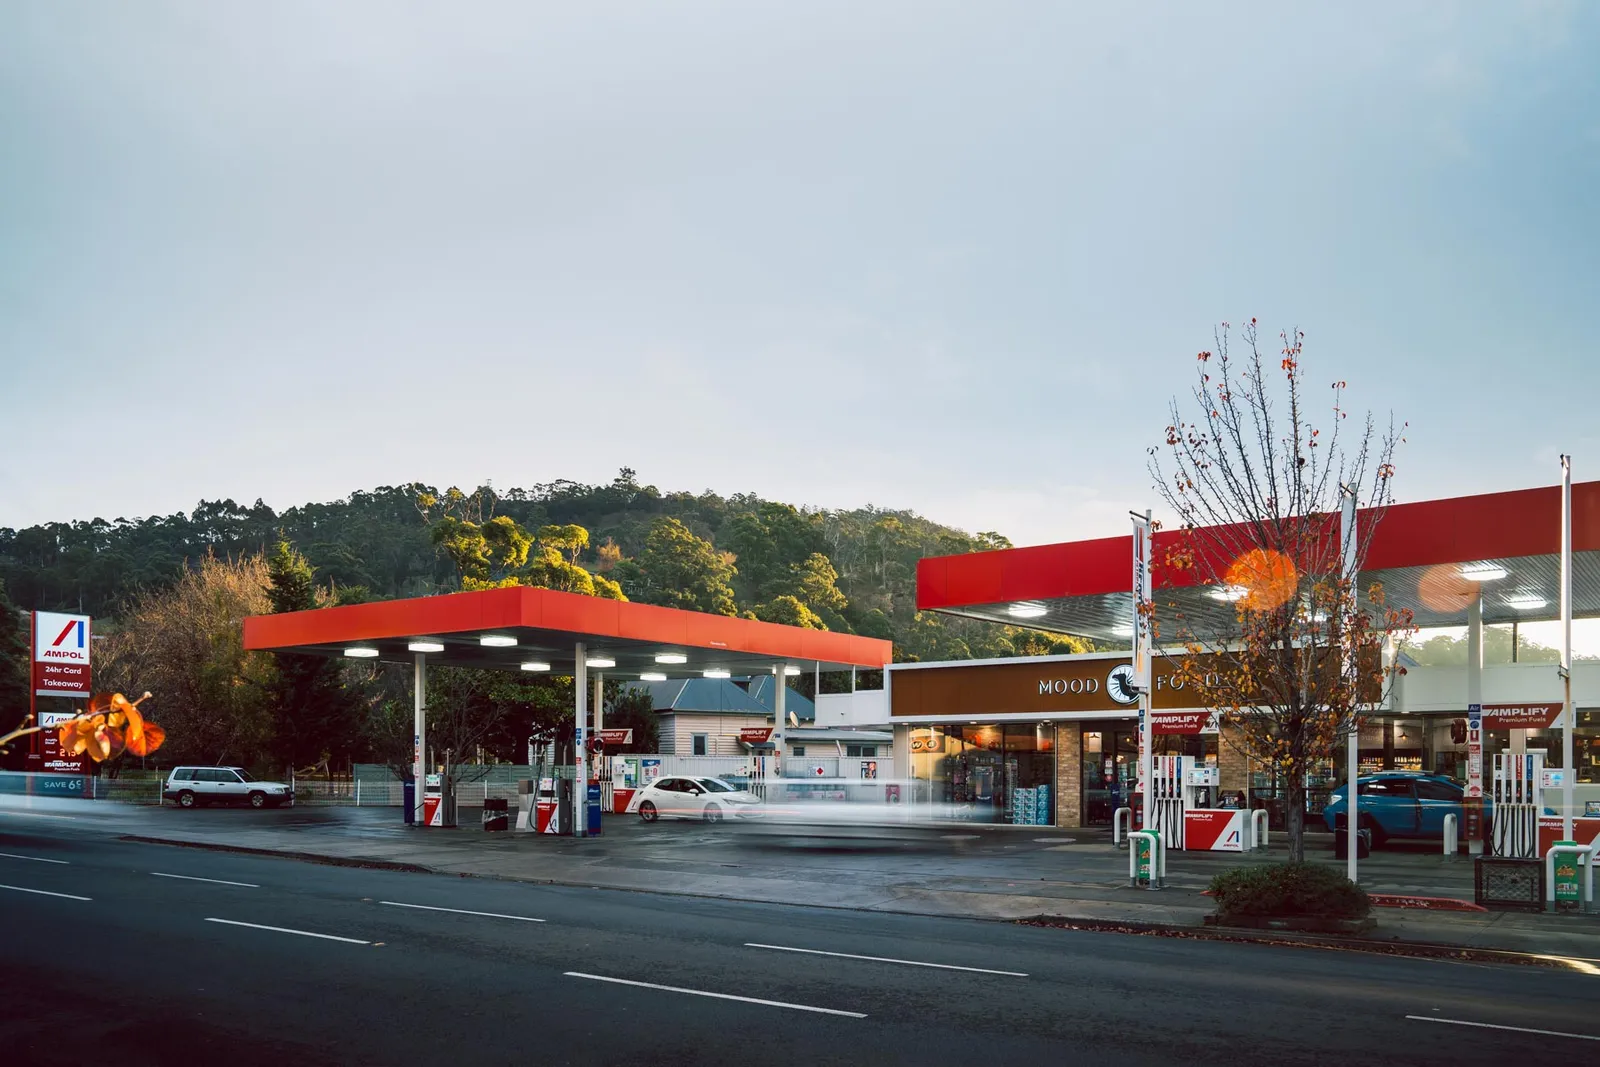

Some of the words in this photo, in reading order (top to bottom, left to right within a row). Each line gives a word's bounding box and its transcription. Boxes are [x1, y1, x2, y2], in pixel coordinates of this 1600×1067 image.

[44, 650, 84, 659] AMPOL
[45, 665, 62, 673] 24hr
[63, 667, 82, 675] Card
[43, 679, 84, 689] Takeaway
[1039, 678, 1098, 695] MOOD
[1156, 674, 1219, 691] FOD
[1490, 707, 1549, 717] AMPLIFY
[1155, 715, 1200, 723] AMPLIFY
